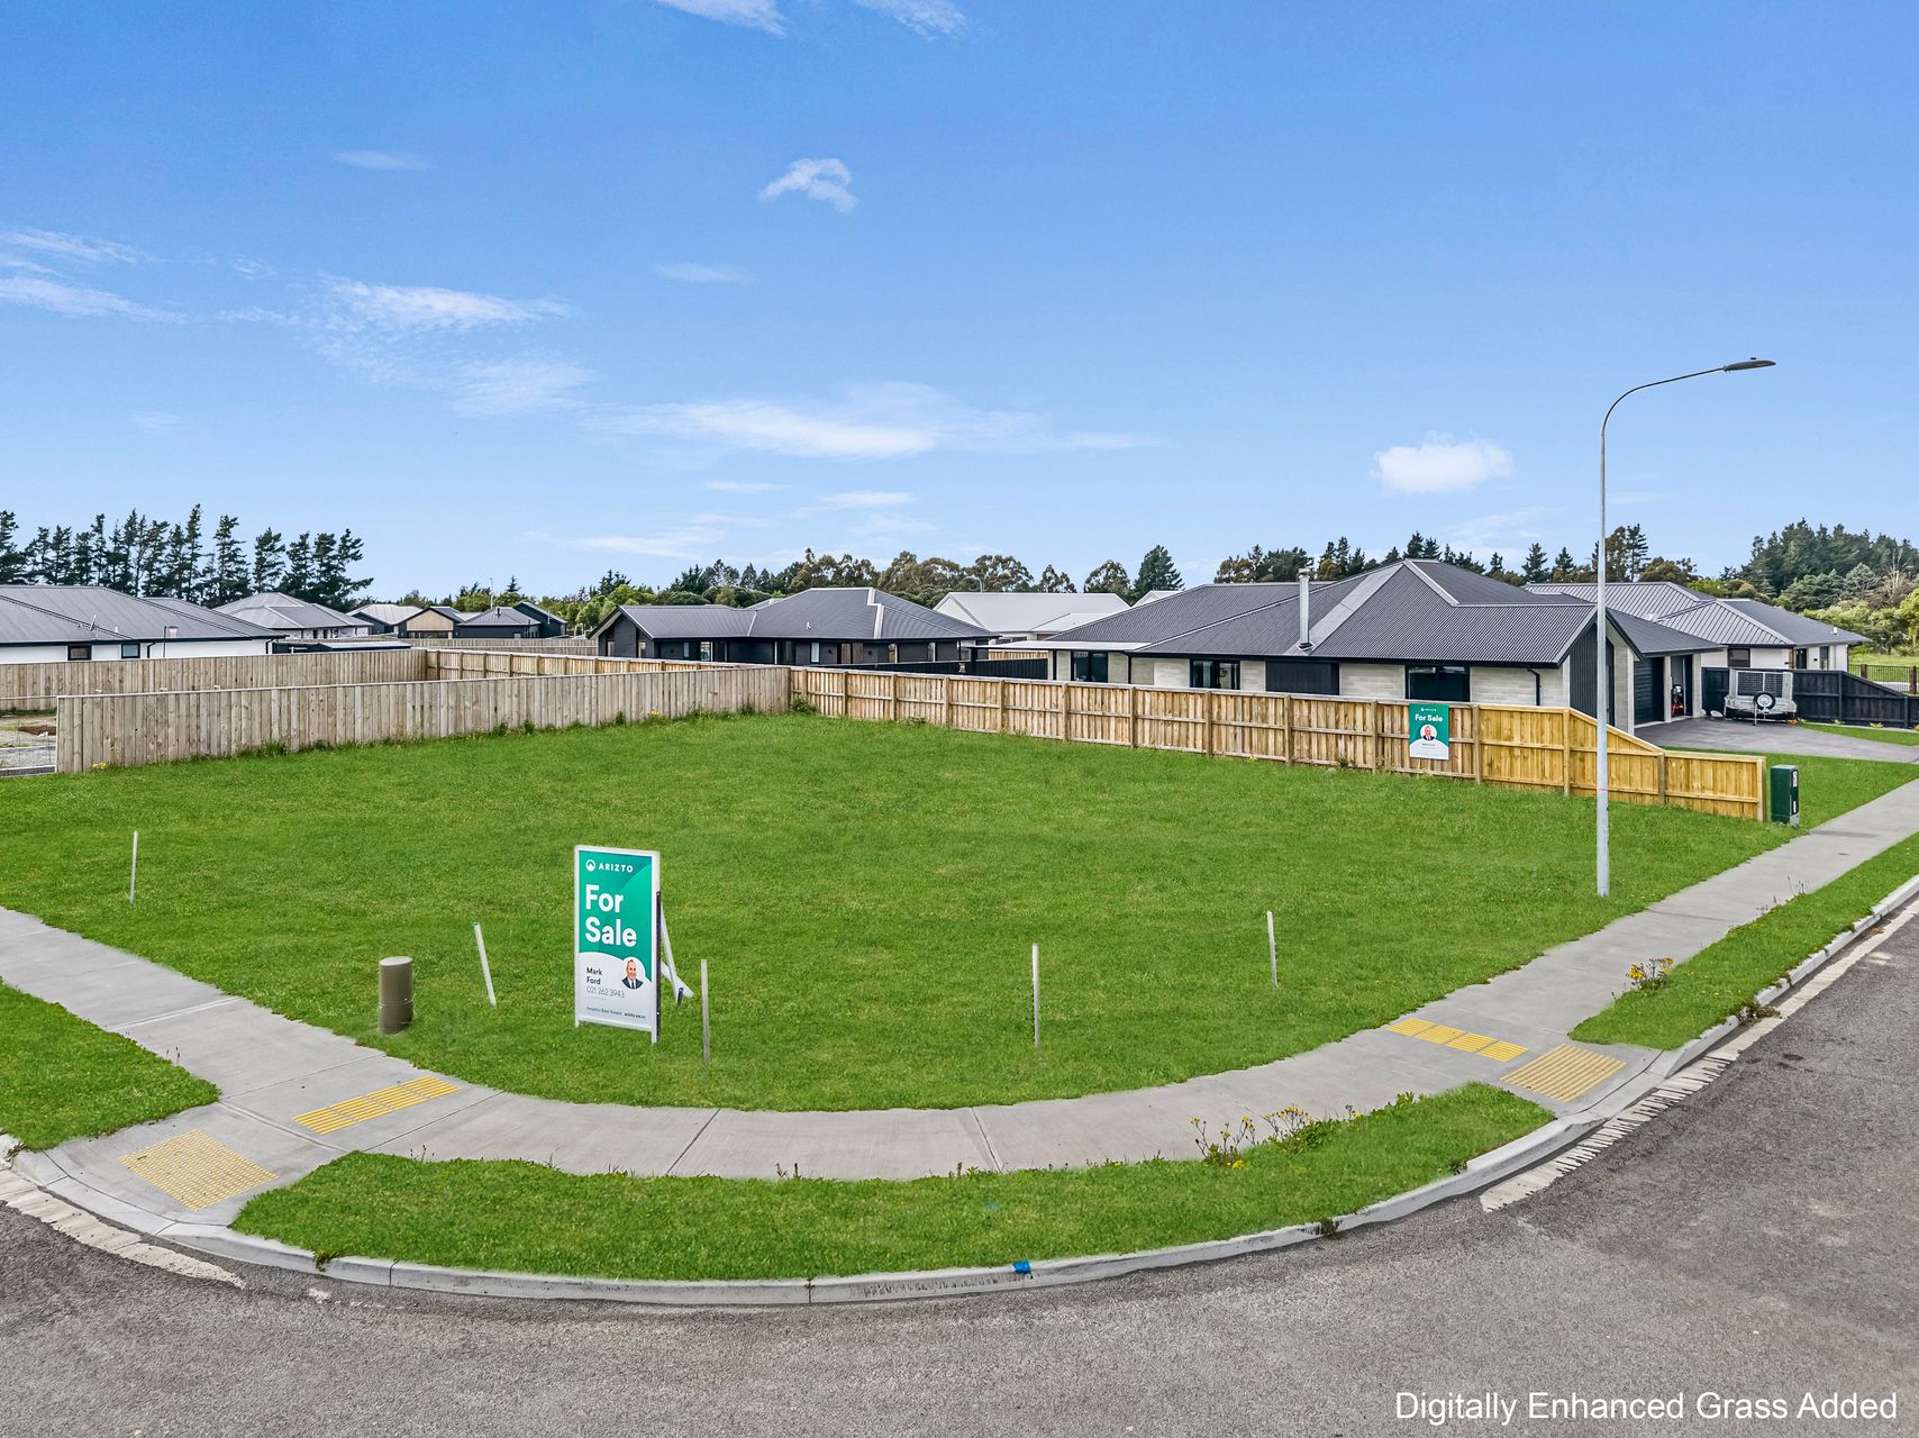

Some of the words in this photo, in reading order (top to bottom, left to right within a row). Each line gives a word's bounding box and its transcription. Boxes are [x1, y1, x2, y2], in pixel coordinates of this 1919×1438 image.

[1415, 713, 1426, 721] For
[1427, 714, 1443, 722] Sale
[598, 862, 634, 873] ARIZTO
[585, 883, 625, 913] For
[584, 916, 637, 947] Sale
[586, 966, 603, 976] Mark
[586, 975, 601, 985] Ford
